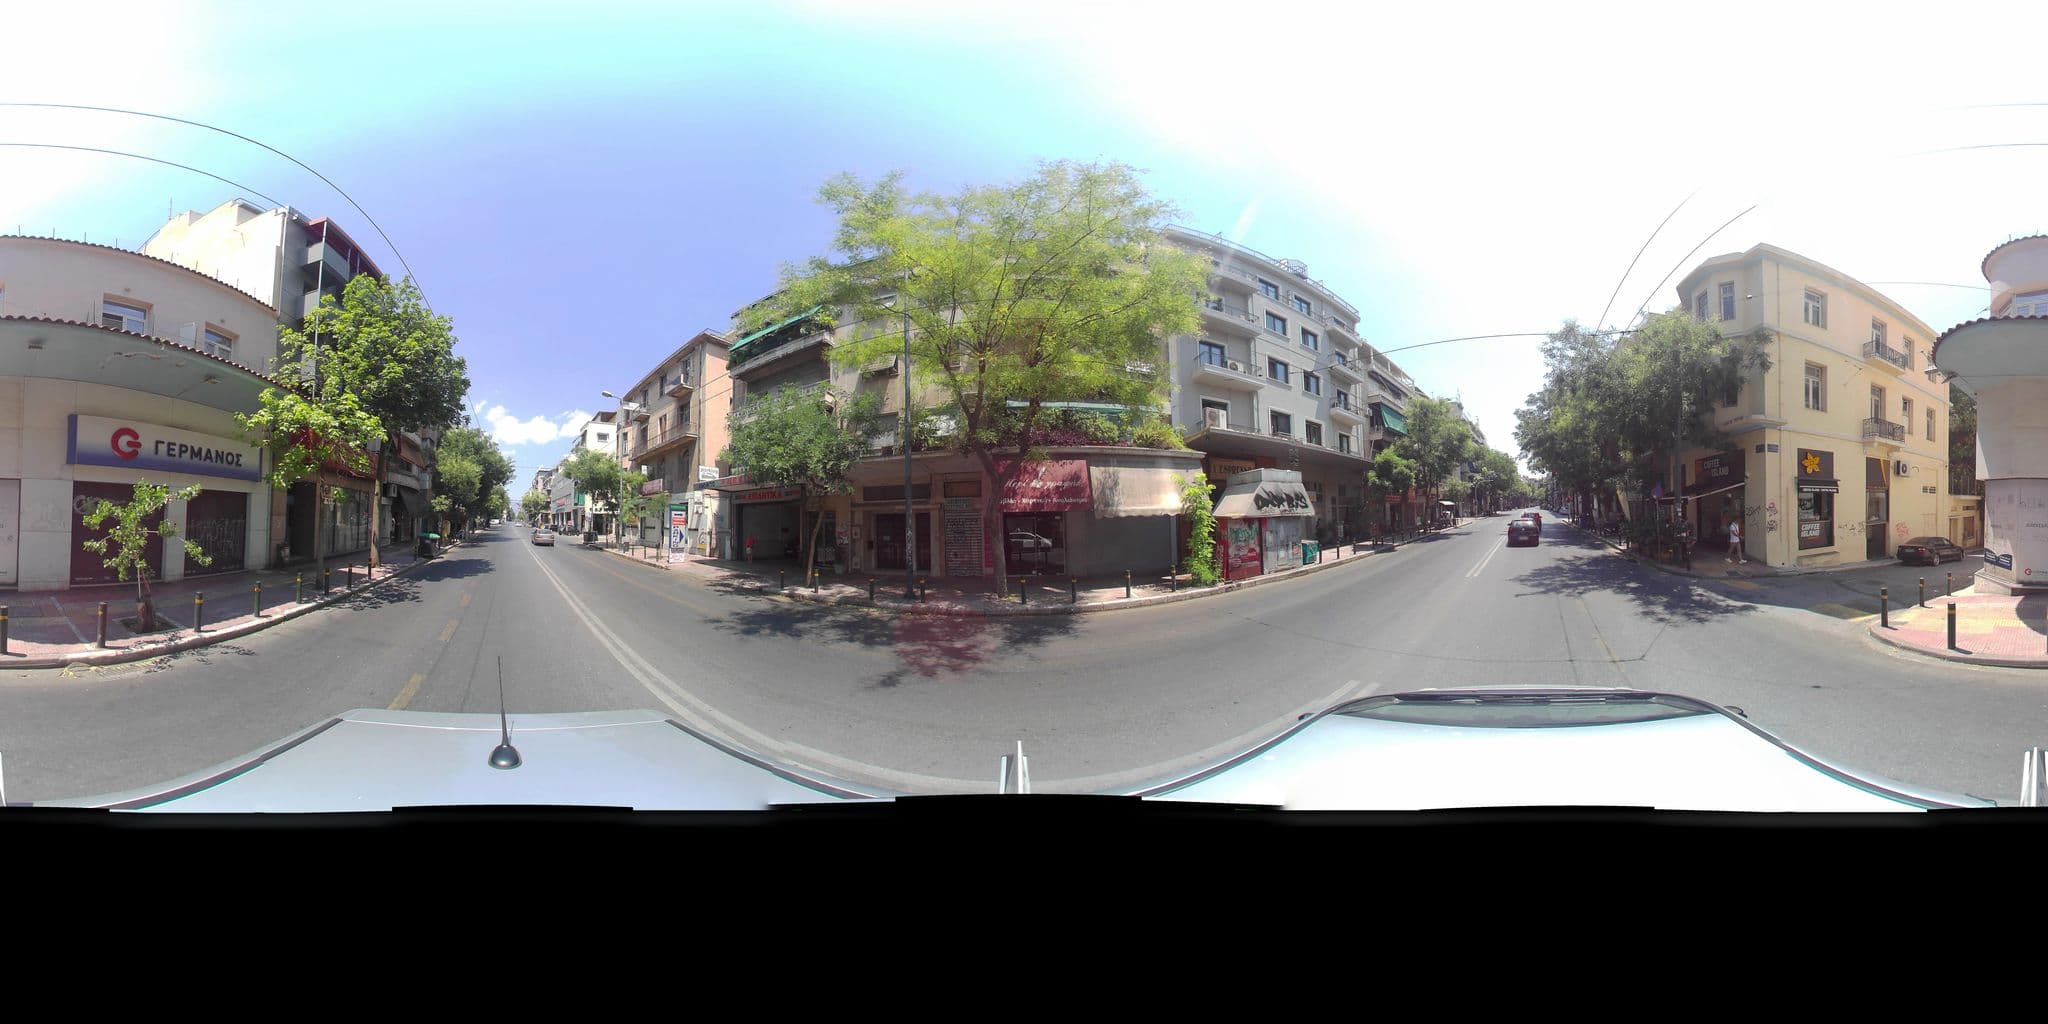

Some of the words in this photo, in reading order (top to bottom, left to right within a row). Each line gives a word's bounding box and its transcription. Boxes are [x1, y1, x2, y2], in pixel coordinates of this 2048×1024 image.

[154, 439, 243, 468] ΓΕΡΜΑΝΟΣ
[1703, 458, 1720, 469] COFFEE
[1711, 466, 1729, 477] ISLAND
[1801, 523, 1820, 531] COFFEE
